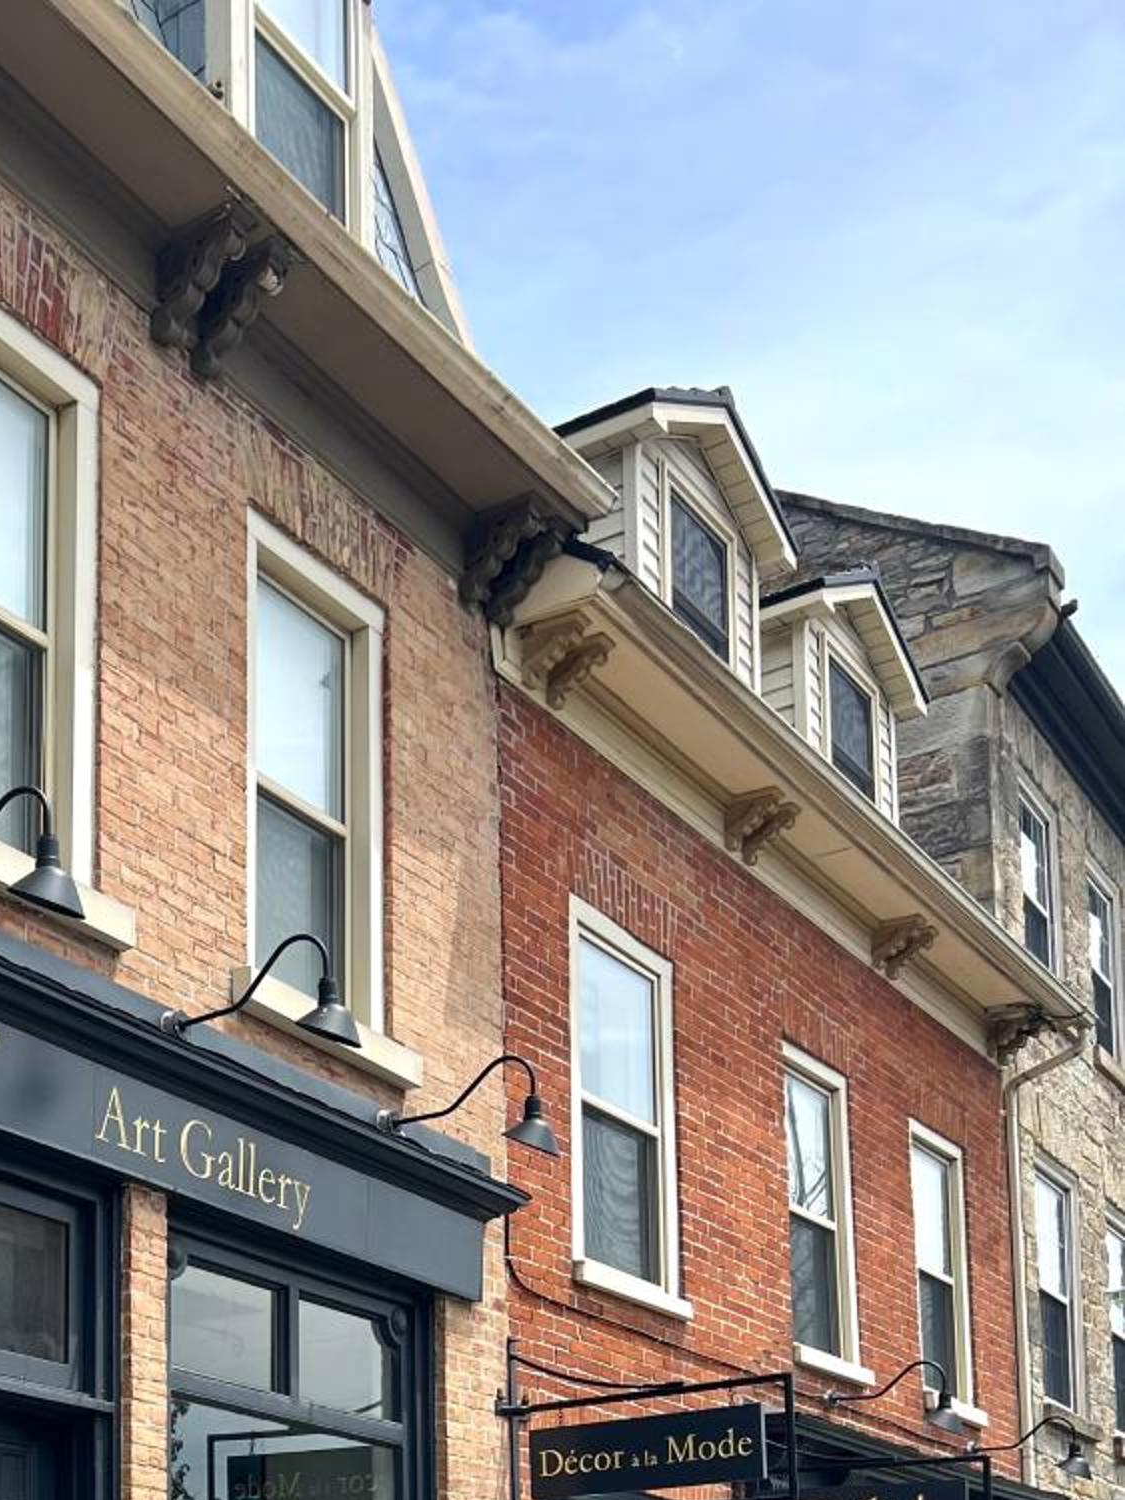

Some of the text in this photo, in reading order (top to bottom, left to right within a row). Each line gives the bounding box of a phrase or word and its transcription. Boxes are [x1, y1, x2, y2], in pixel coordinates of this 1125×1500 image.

[95, 1086, 312, 1231] Art Gallery
[539, 1427, 754, 1478] Décor à la Mode
